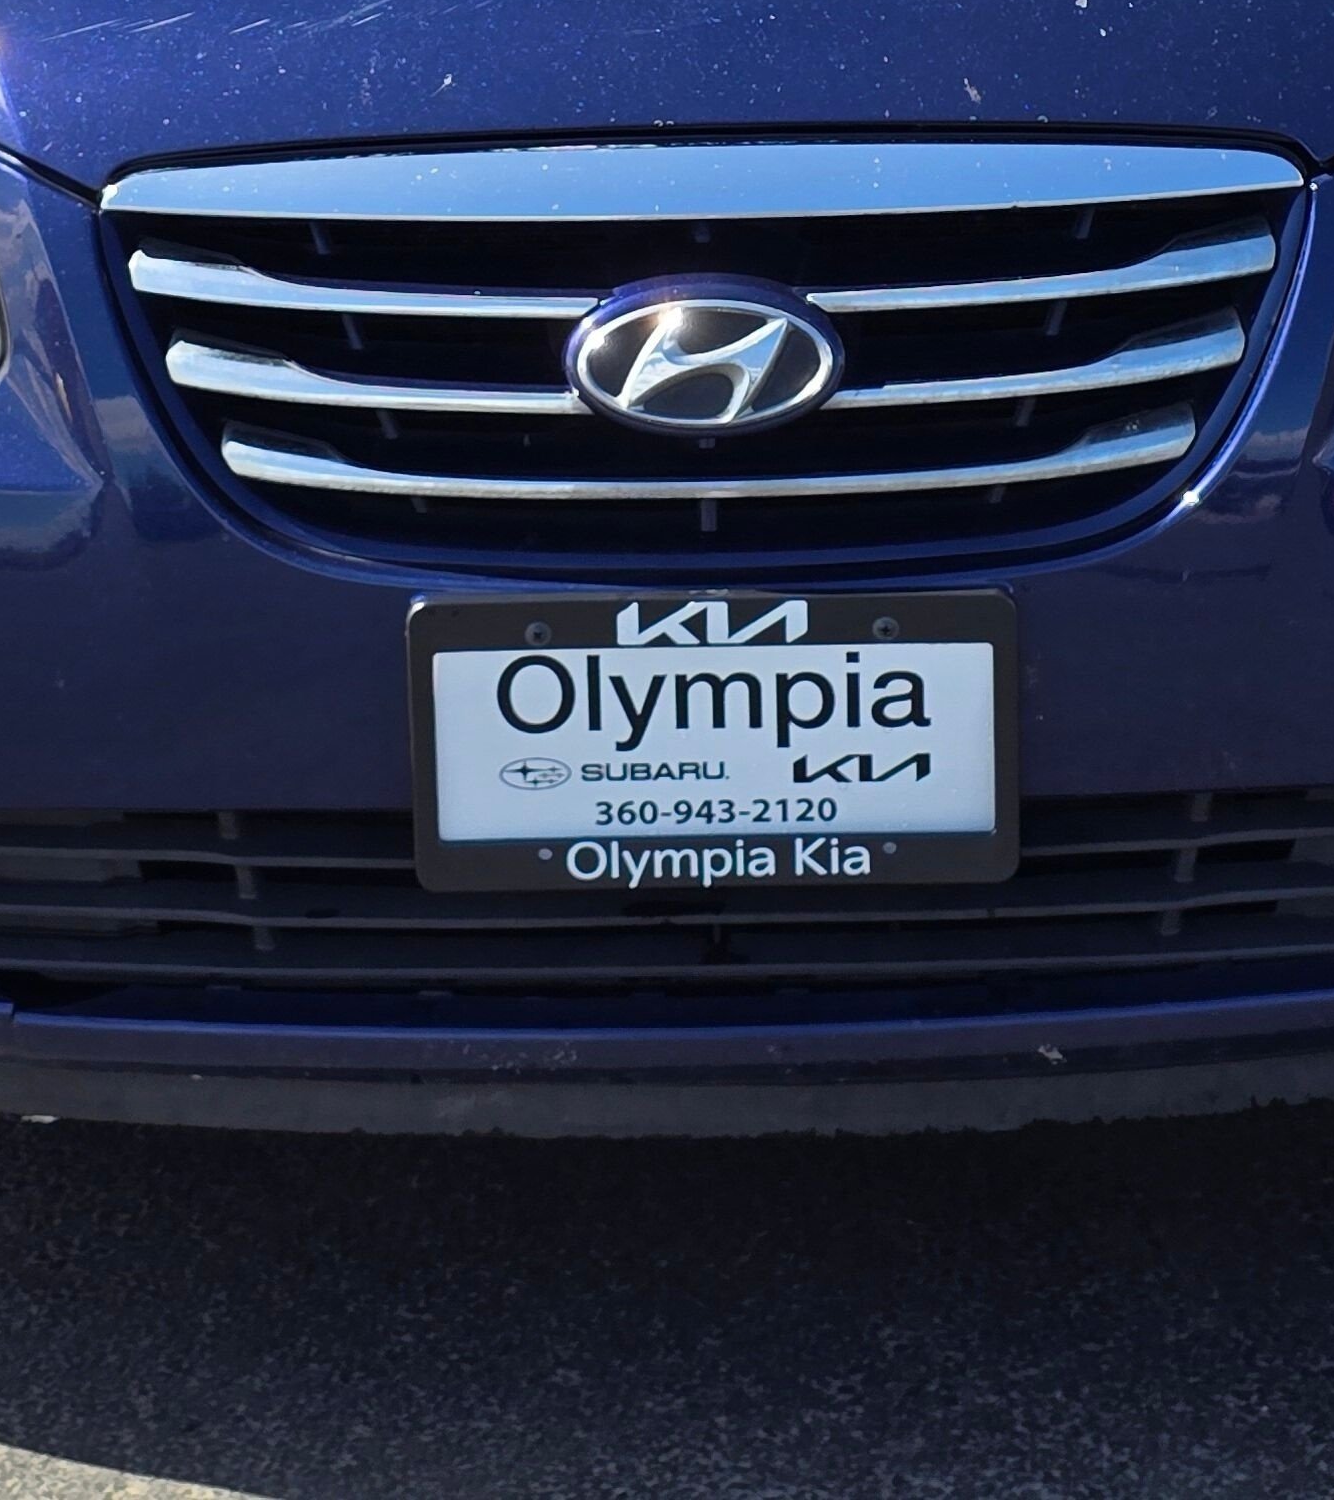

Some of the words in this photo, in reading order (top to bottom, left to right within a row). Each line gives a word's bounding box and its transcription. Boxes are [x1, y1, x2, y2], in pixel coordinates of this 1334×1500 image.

[616, 599, 808, 646] KIA
[497, 652, 931, 751] Olympia
[581, 761, 726, 781] SUBARU
[793, 752, 931, 783] KIA
[595, 797, 838, 826] 360-943-2120
[566, 839, 777, 888] Olympia
[794, 837, 871, 876] Kia
